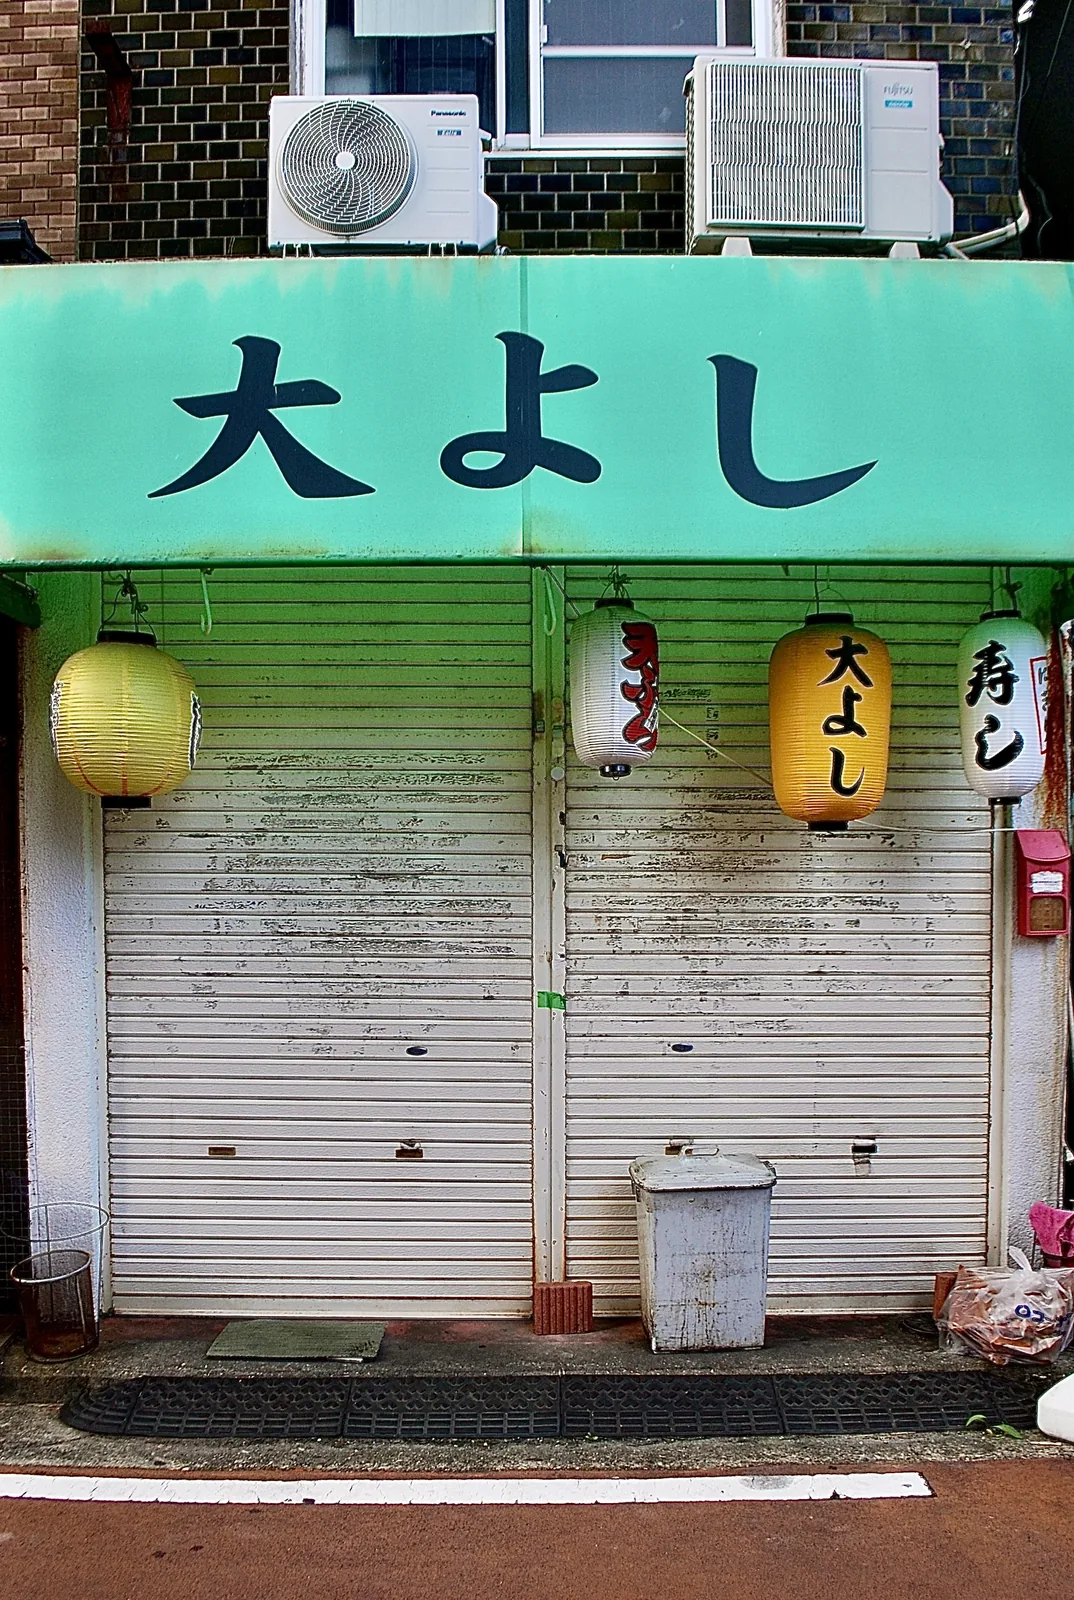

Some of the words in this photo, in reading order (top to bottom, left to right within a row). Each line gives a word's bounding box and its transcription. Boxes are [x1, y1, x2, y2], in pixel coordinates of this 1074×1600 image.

[430, 109, 467, 117] Panasonic
[147, 331, 879, 509] 大よし
[816, 635, 874, 797] 大よし
[965, 640, 1024, 771] 寿し
